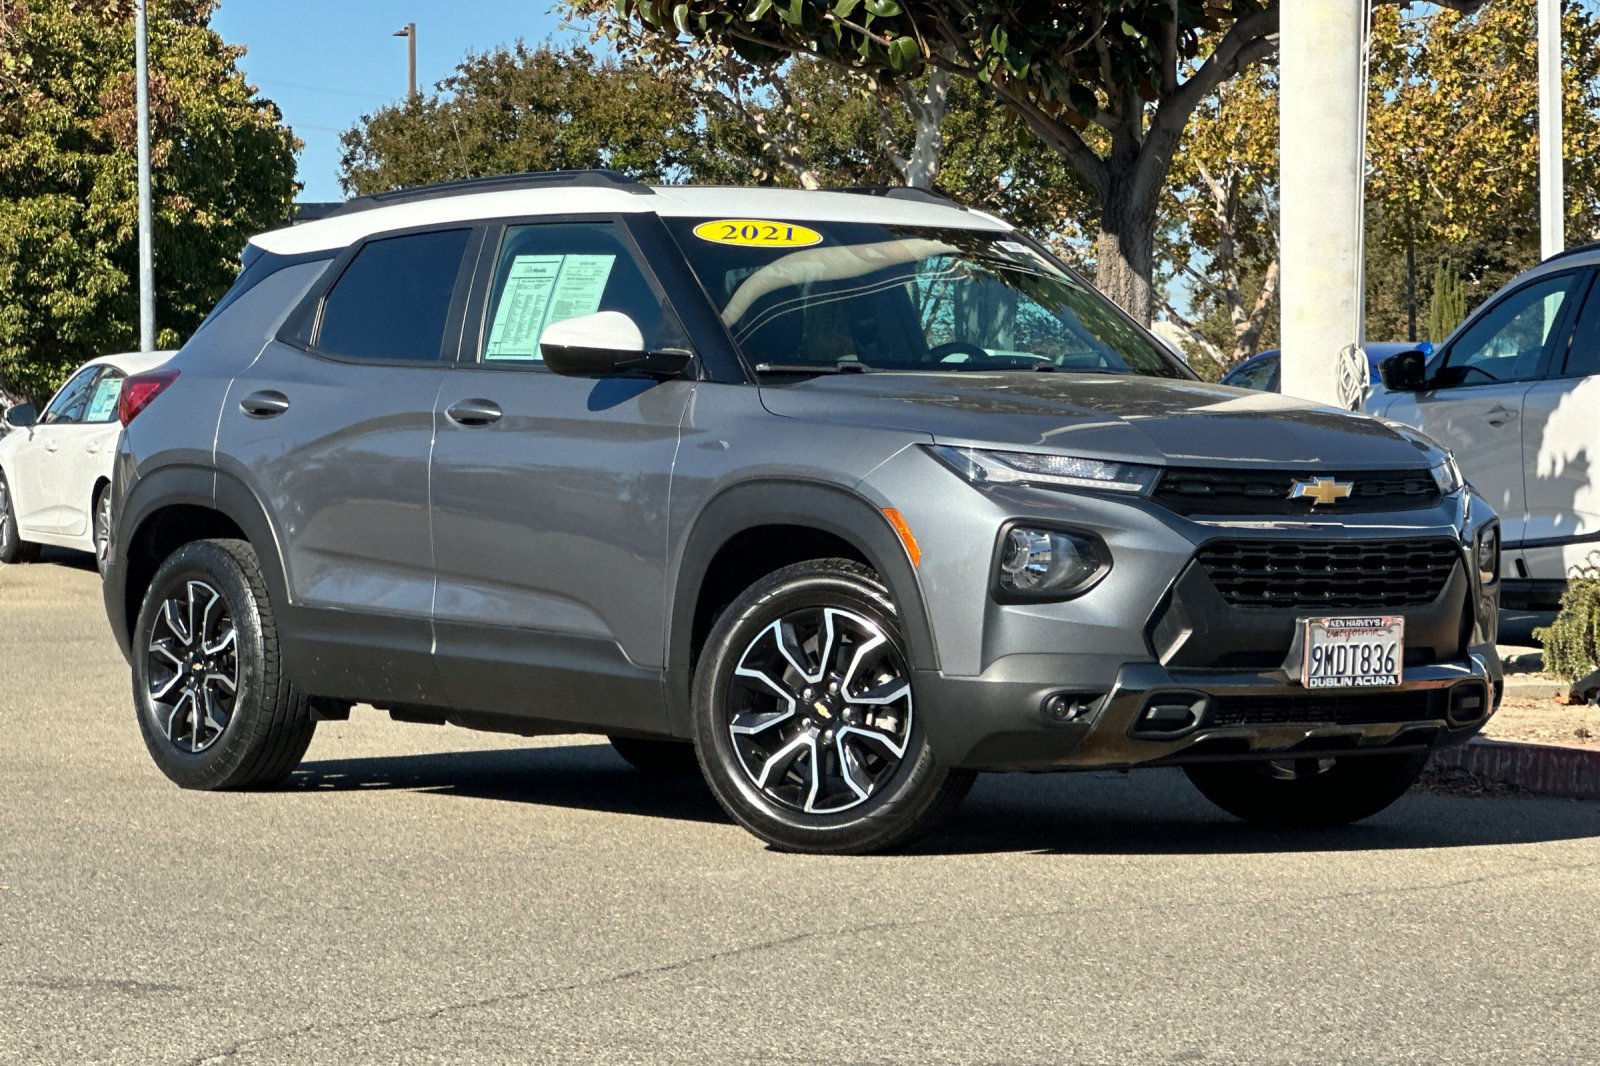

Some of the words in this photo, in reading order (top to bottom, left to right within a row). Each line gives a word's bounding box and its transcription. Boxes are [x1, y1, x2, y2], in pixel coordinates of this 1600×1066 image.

[720, 224, 797, 241] 2021
[1330, 619, 1345, 627] KEN
[1346, 619, 1380, 627] HARVEY'S
[1311, 642, 1396, 675] 9MDT836
[1309, 677, 1353, 687] DUBLIN
[1354, 675, 1396, 686] ACURA
